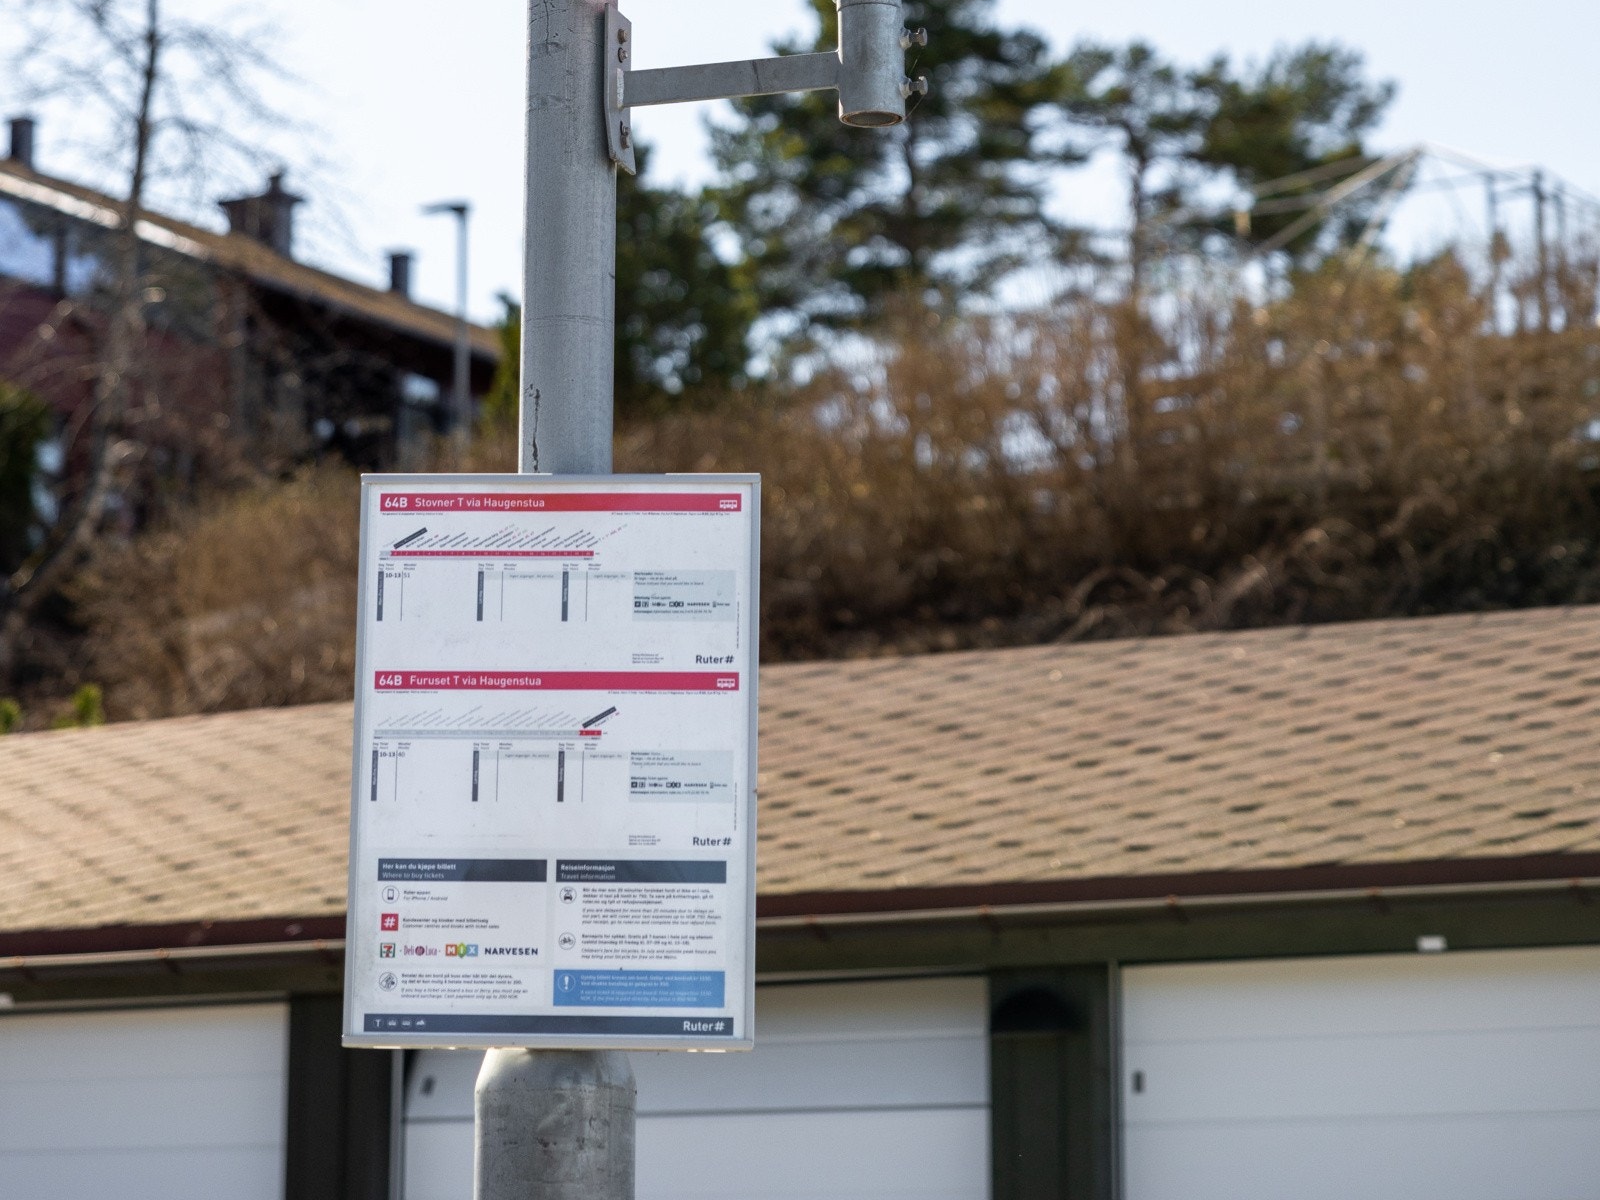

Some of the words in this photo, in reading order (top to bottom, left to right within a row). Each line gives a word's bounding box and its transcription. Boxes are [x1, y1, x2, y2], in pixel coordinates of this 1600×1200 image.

[384, 497, 408, 508] 64B
[415, 497, 454, 508] Stovner
[458, 498, 464, 507] T
[466, 498, 481, 507] via
[484, 498, 545, 510] Haugenstua
[379, 675, 402, 686] 64B
[410, 675, 450, 685] Furuset
[453, 676, 460, 685] T
[462, 676, 477, 686] via
[480, 676, 542, 688] Haugenstua
[418, 864, 436, 872] kjøpe
[561, 864, 615, 872] Reiseinformasjon
[411, 872, 423, 880] buy
[484, 947, 538, 956] NARVESEN
[683, 1020, 724, 1032] Ruter#
